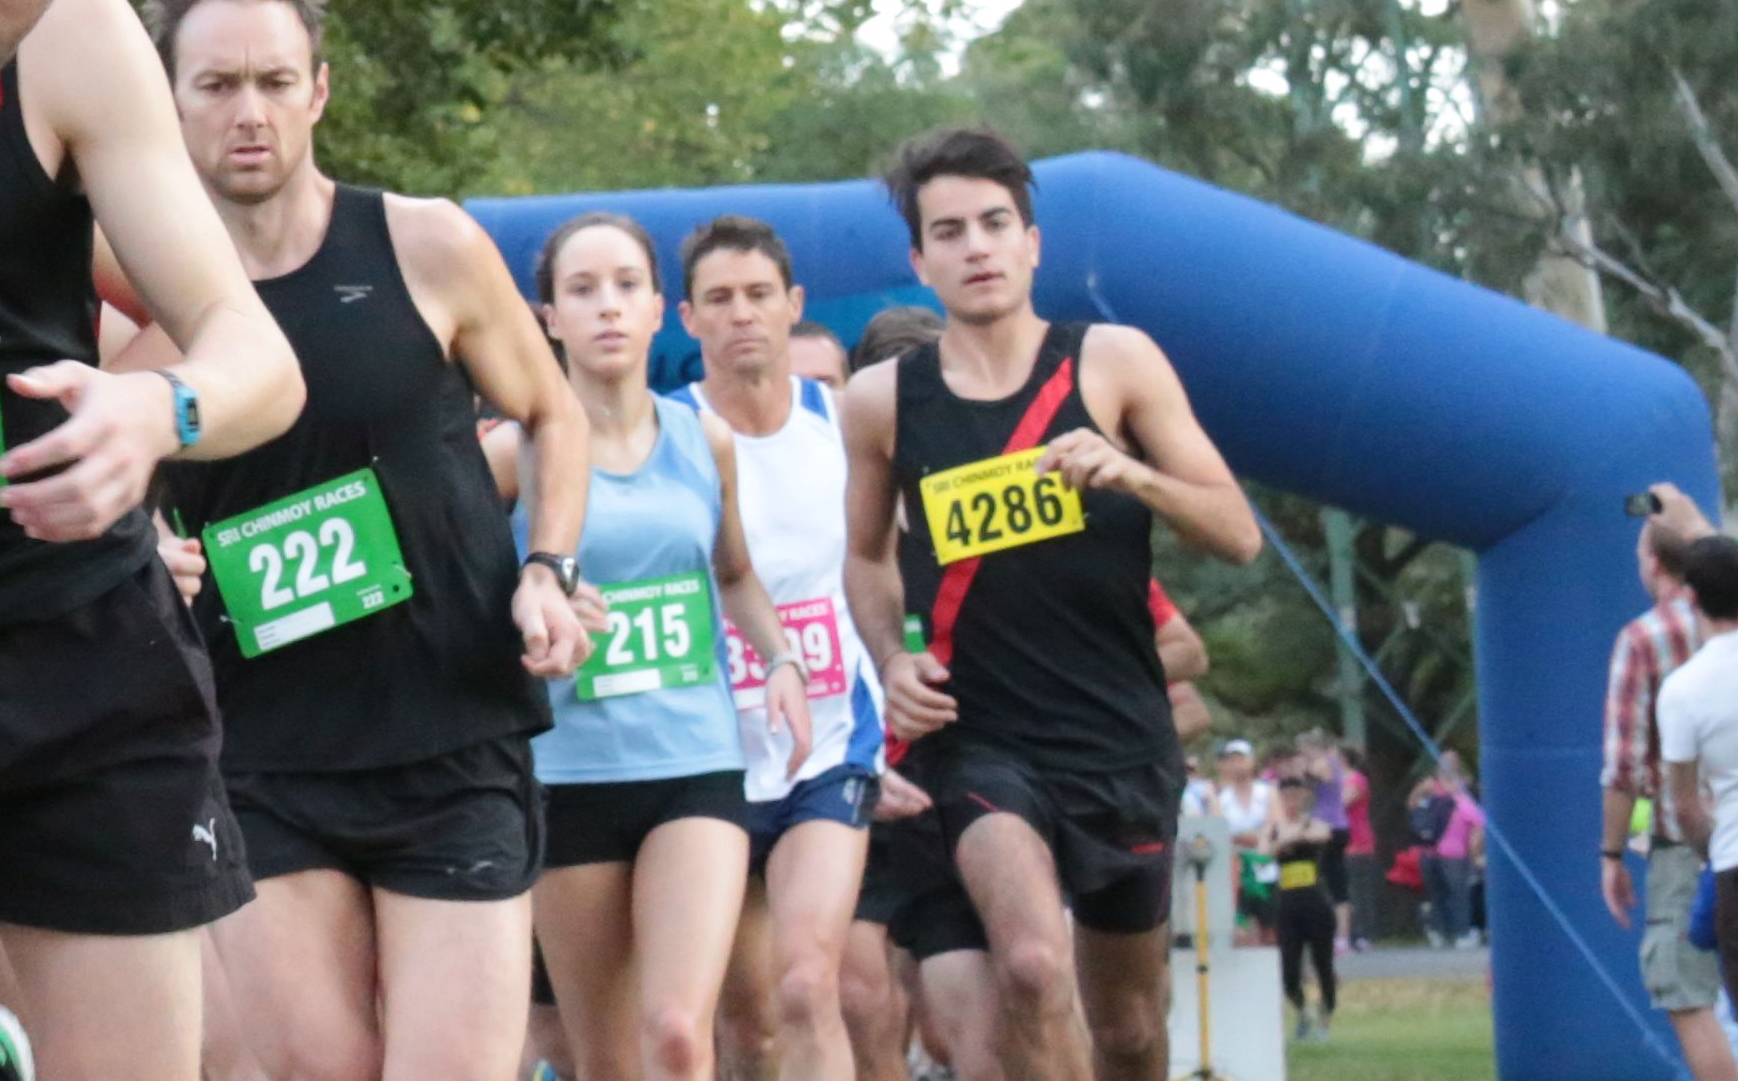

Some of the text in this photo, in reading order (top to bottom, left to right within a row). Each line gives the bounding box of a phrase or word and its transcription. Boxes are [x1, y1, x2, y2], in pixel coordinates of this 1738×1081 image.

[217, 480, 367, 548] SRI CHINMOY RACES
[945, 478, 1064, 547] 4286
[249, 517, 367, 611] 222
[606, 603, 690, 666] 215
